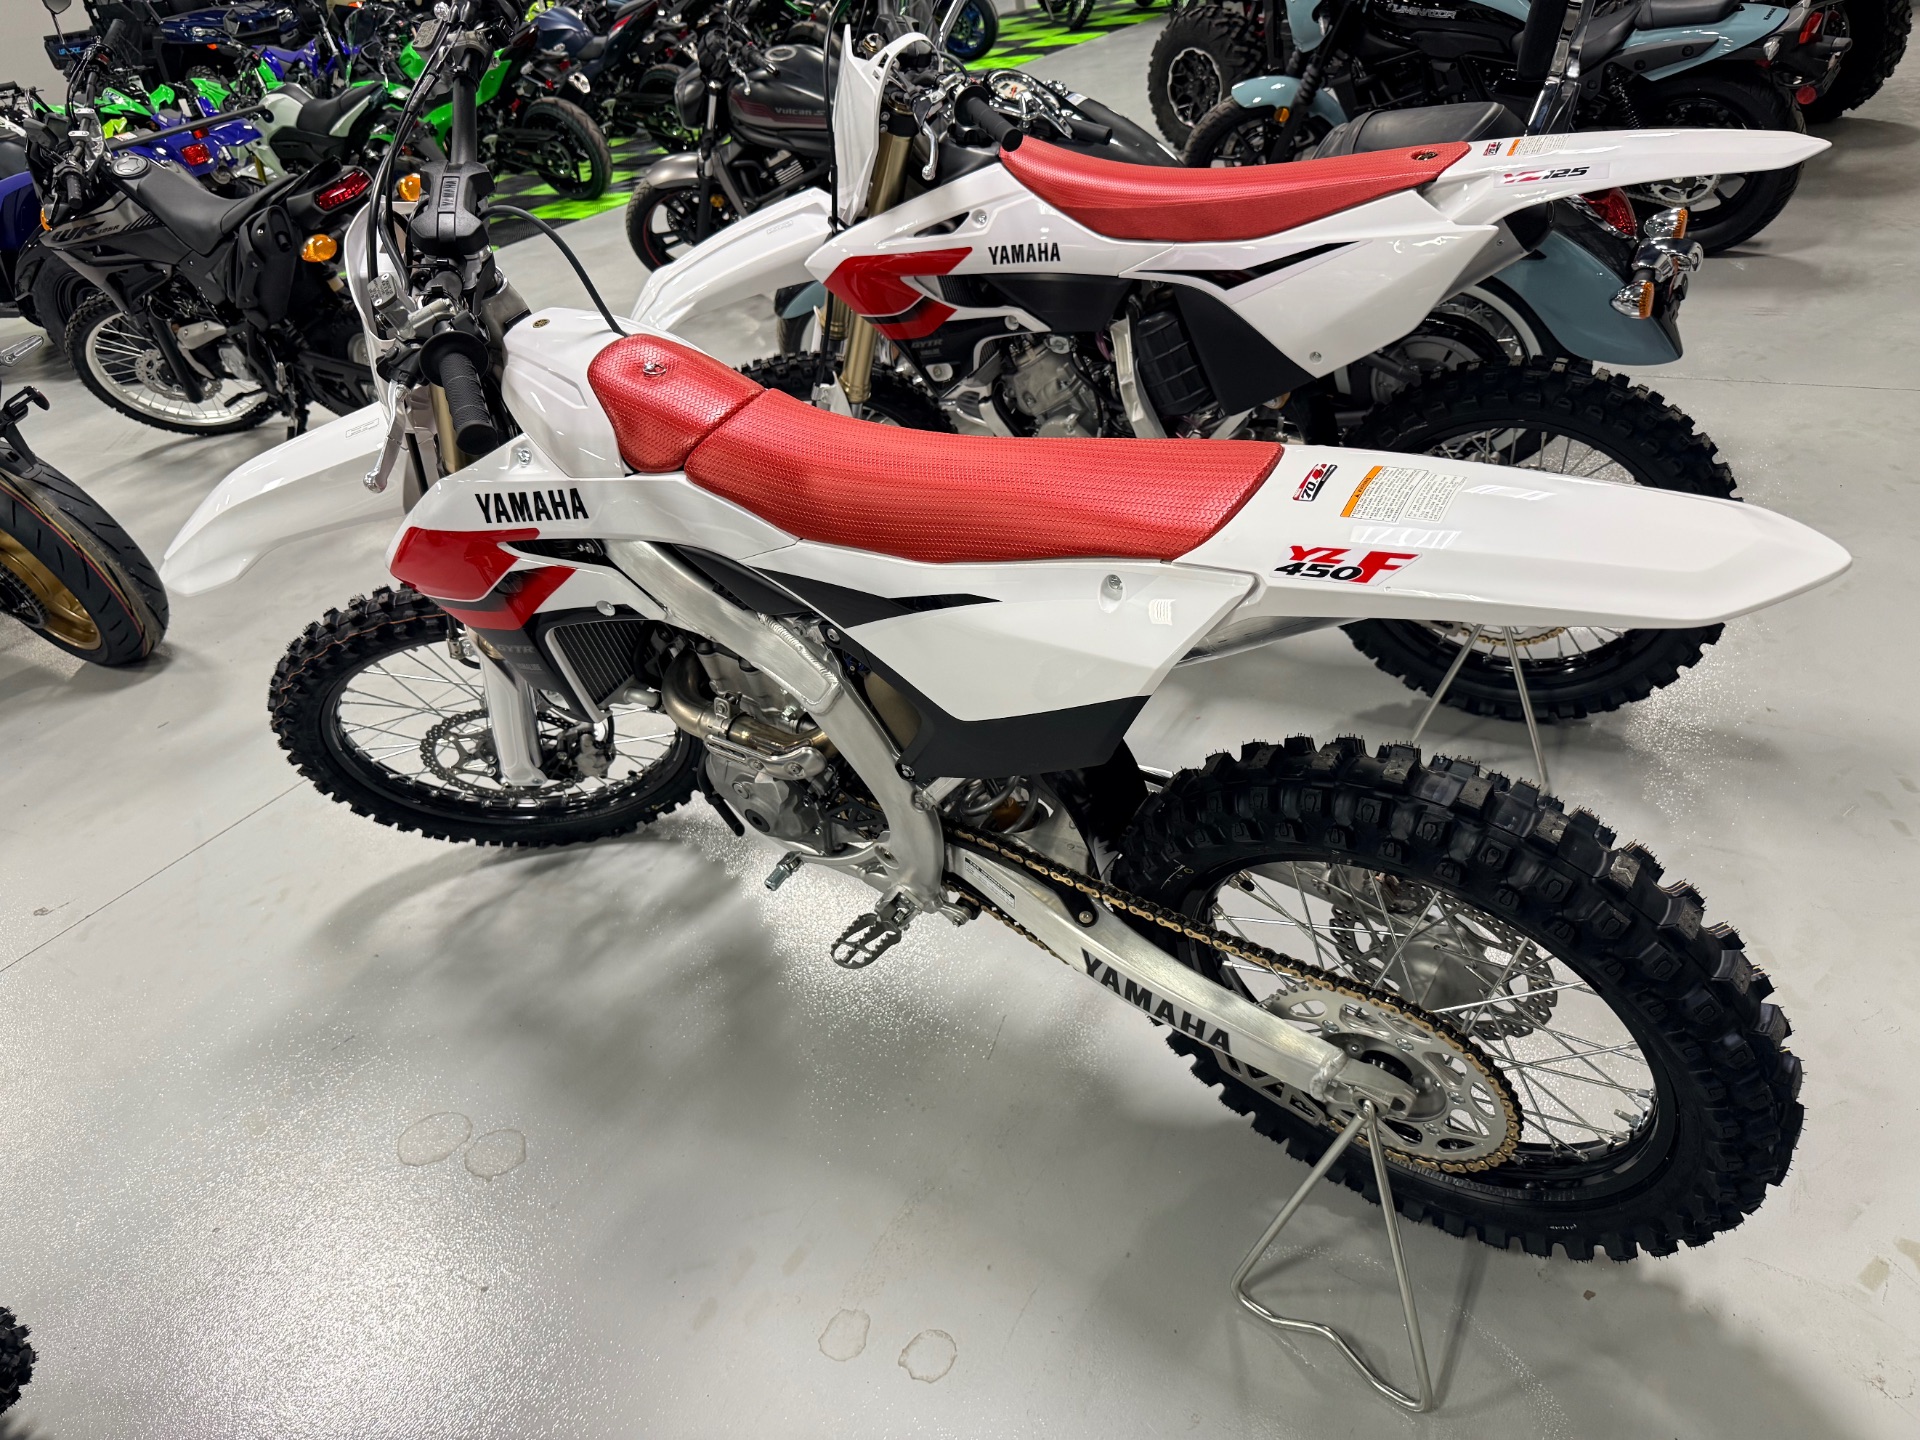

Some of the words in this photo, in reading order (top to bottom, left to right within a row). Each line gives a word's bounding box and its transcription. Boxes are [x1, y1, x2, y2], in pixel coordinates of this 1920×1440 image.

[774, 107, 812, 116] Vulcan
[441, 180, 457, 207] YAMAHA
[988, 242, 1061, 265] YAMAHA
[1301, 481, 1317, 499] 70
[474, 488, 589, 523] YAMAHA
[496, 644, 535, 653] GYTR
[1081, 947, 1231, 1054] YAMAHA
